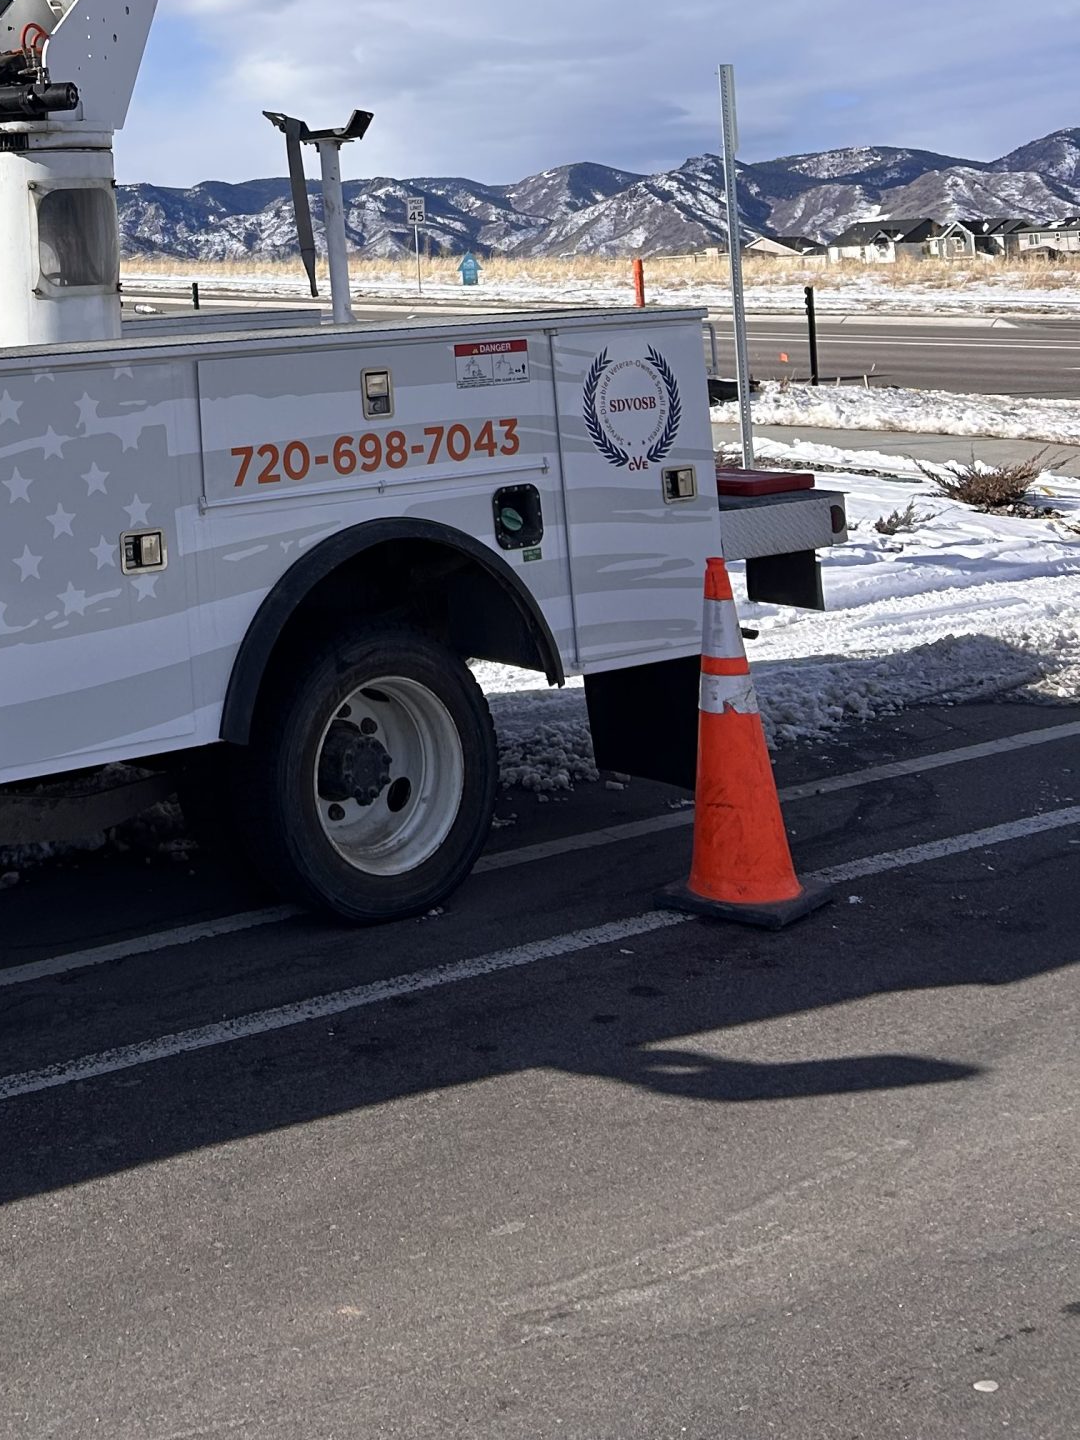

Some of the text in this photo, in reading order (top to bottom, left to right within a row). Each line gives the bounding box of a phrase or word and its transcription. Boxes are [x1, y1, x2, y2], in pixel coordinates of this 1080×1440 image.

[409, 211, 424, 222] 45
[479, 343, 511, 353] DANGER
[609, 396, 656, 413] SDVOSB
[230, 418, 520, 487] 720-698-7043
